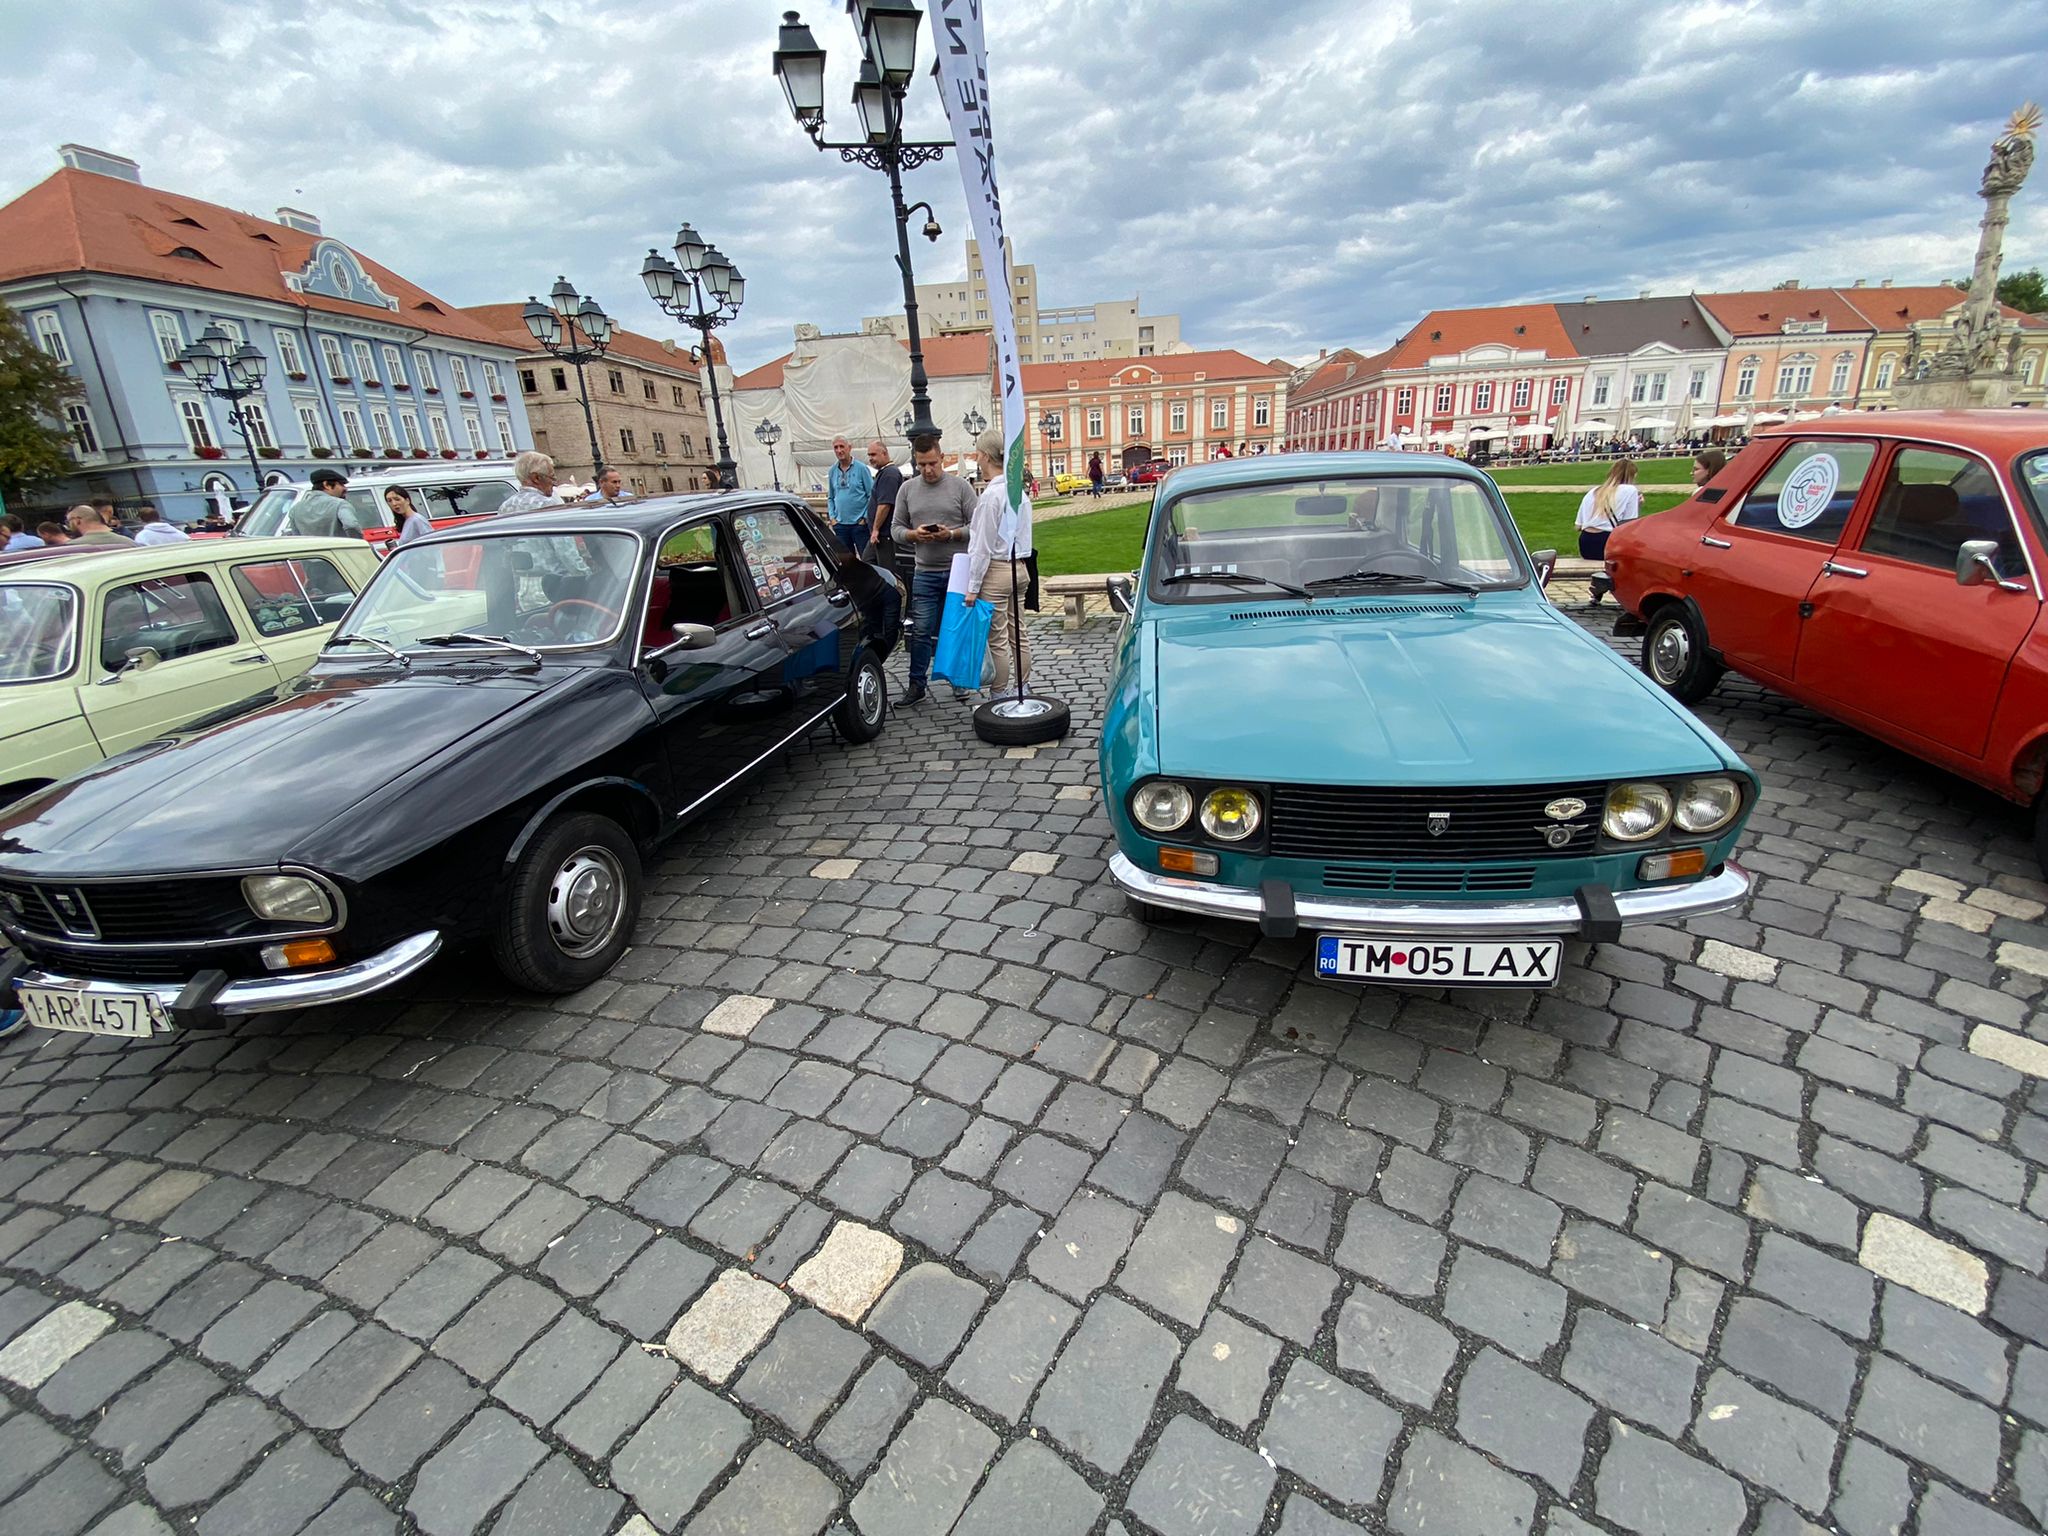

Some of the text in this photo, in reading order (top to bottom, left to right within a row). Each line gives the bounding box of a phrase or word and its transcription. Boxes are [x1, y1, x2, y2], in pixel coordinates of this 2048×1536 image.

[1319, 957, 1336, 969] RO
[1463, 947, 1553, 977] LAX
[92, 998, 137, 1031] 457
